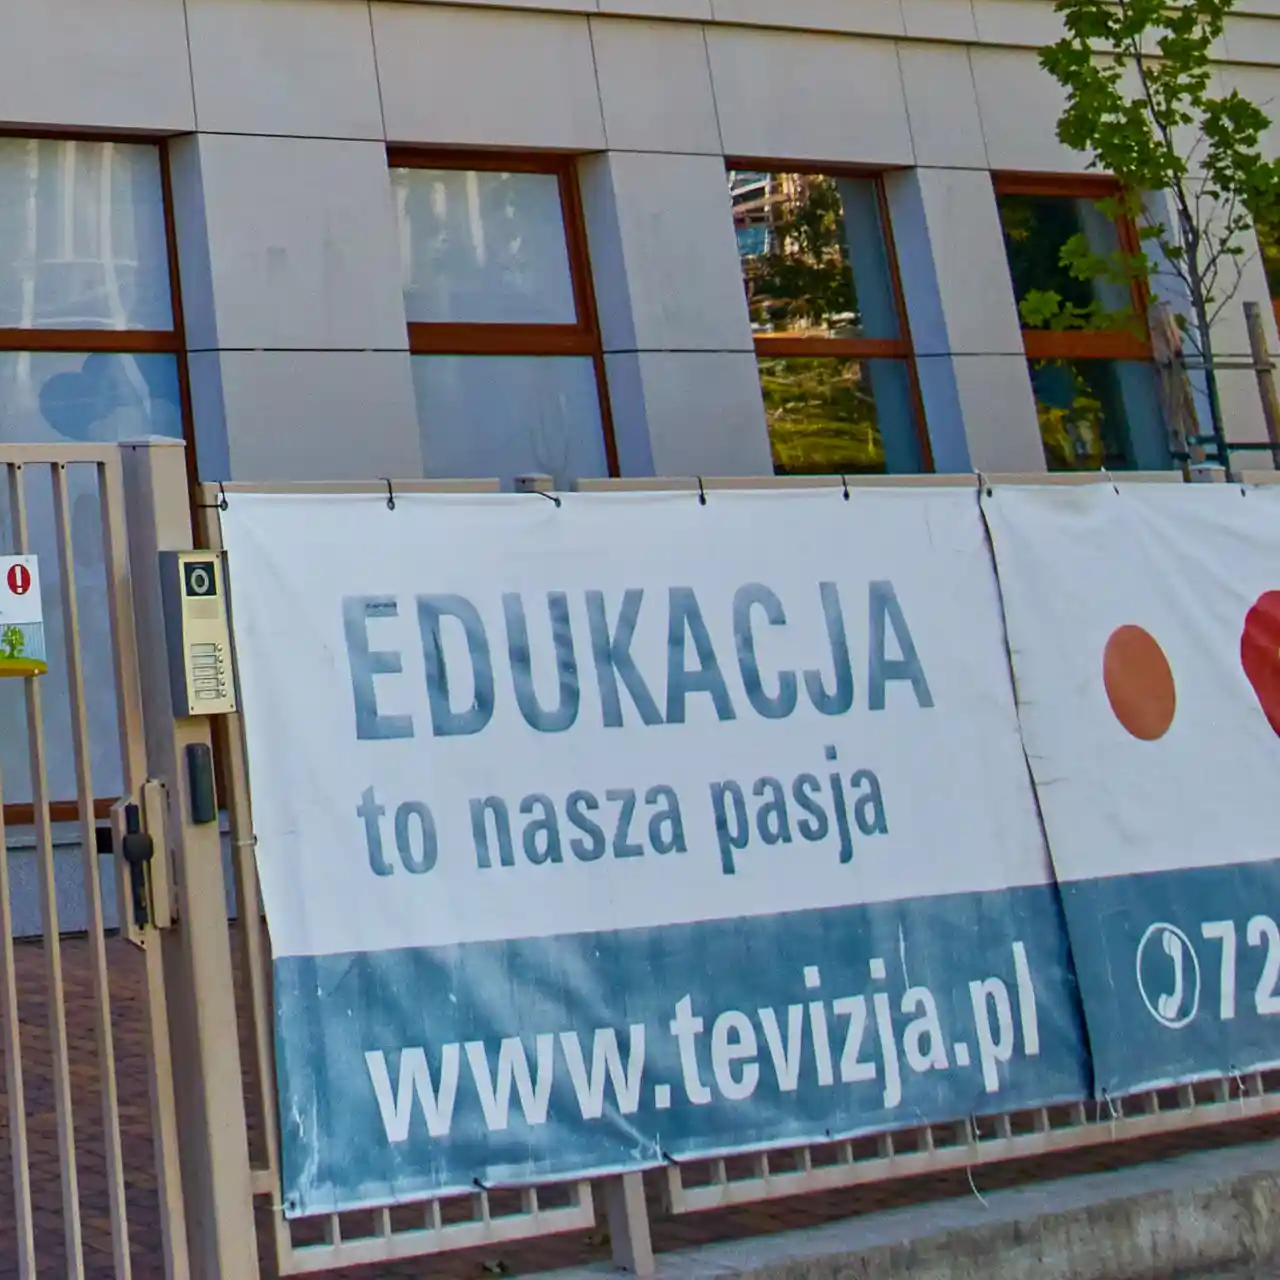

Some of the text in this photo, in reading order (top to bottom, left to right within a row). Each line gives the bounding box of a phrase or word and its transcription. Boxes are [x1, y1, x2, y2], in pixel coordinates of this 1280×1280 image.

[342, 580, 934, 743] EDUKACJA
[358, 745, 890, 877] to nasza pasja
[1200, 914, 1280, 1021] 72
[366, 940, 1040, 1145] www.tevizja.pl
